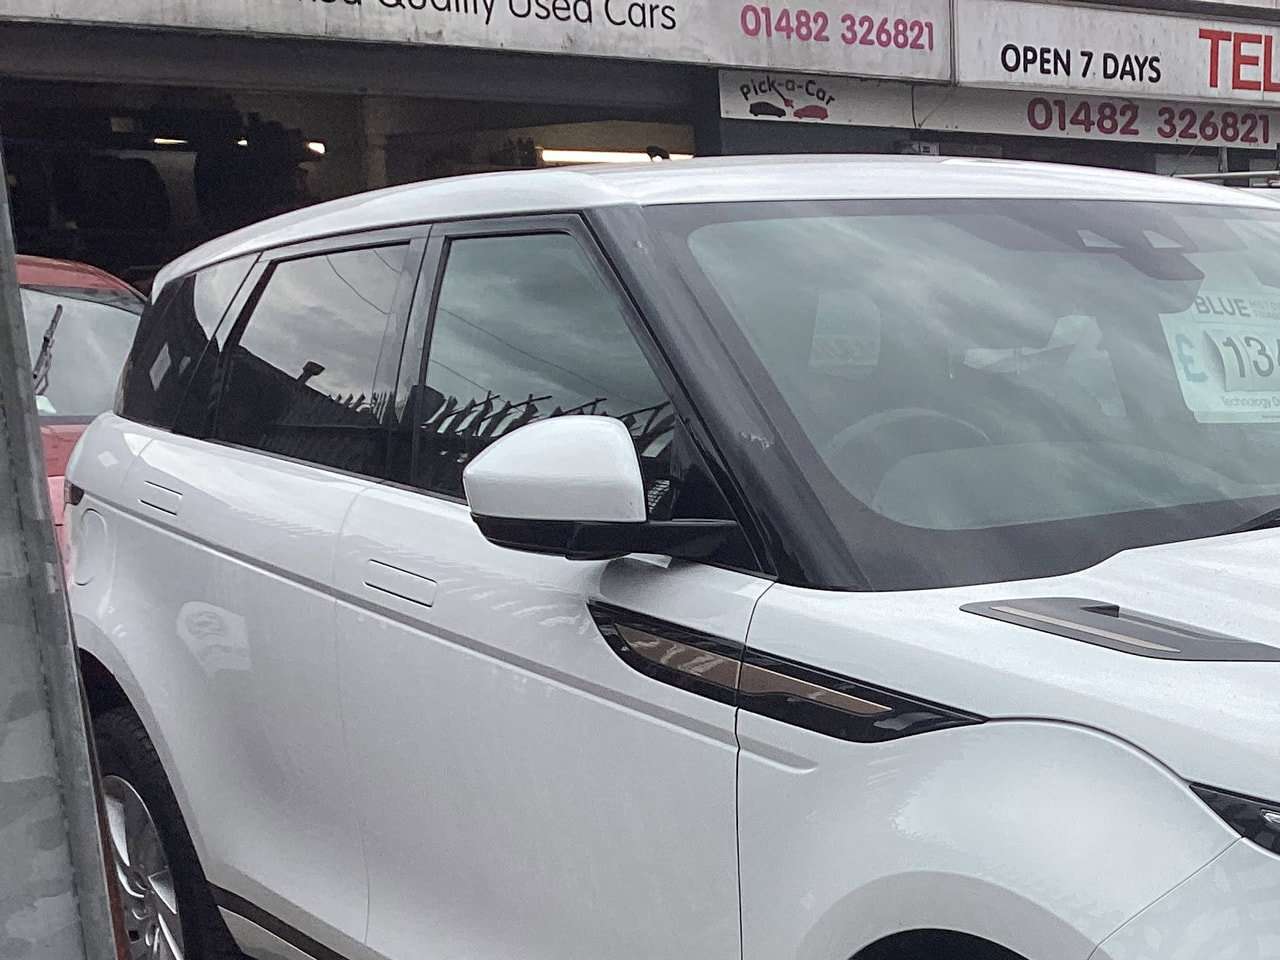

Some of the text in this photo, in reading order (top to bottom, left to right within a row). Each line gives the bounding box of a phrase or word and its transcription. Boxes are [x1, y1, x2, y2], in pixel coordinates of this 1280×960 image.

[509, 0, 593, 23] Used
[604, 0, 677, 30] Cars
[741, 5, 934, 51] 01482 326821
[1001, 44, 1161, 83] OPEN 7 DAYS
[1027, 97, 1139, 136] 01482
[1157, 106, 1269, 144] 326821
[1194, 295, 1251, 318] BLUE
